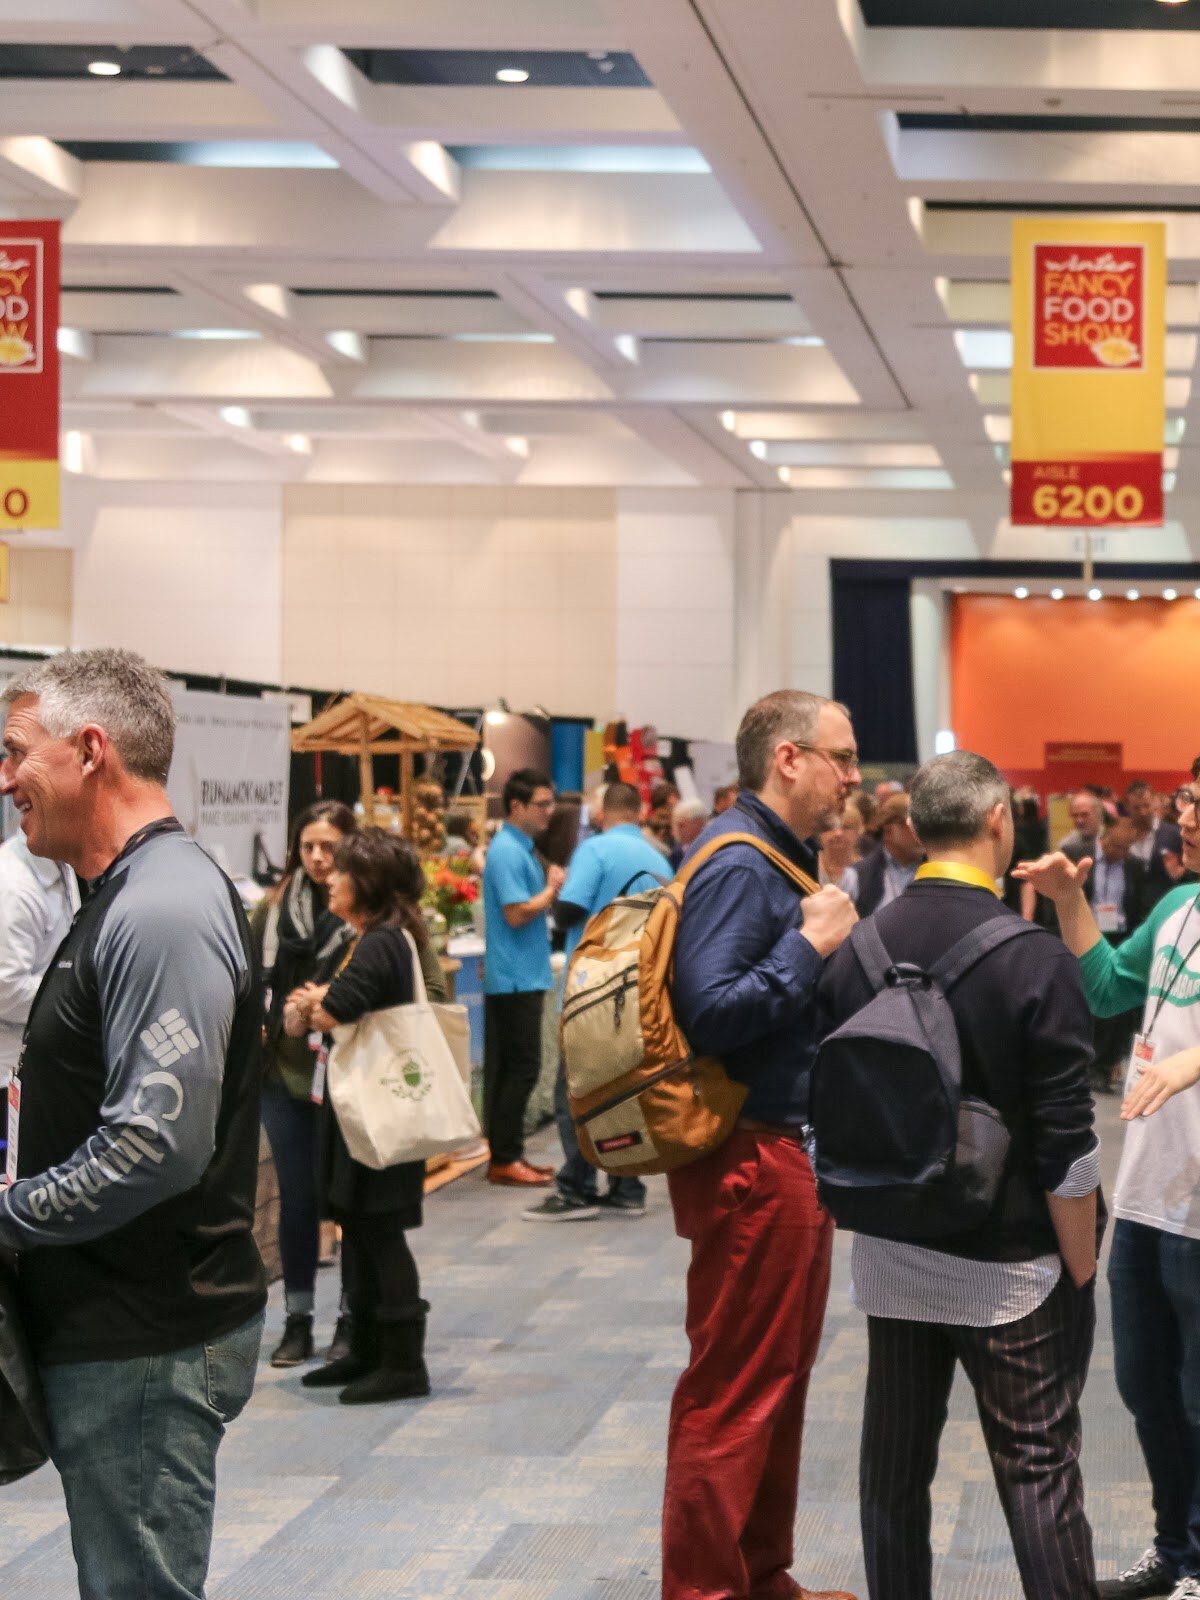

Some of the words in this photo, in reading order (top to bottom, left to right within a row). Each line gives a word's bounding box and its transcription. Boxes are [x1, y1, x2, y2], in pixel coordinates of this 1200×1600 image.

[1044, 272, 1134, 297] FANCY
[1043, 297, 1134, 323] FOOD
[1043, 322, 1134, 347] SHOW
[1032, 484, 1143, 520] 6200
